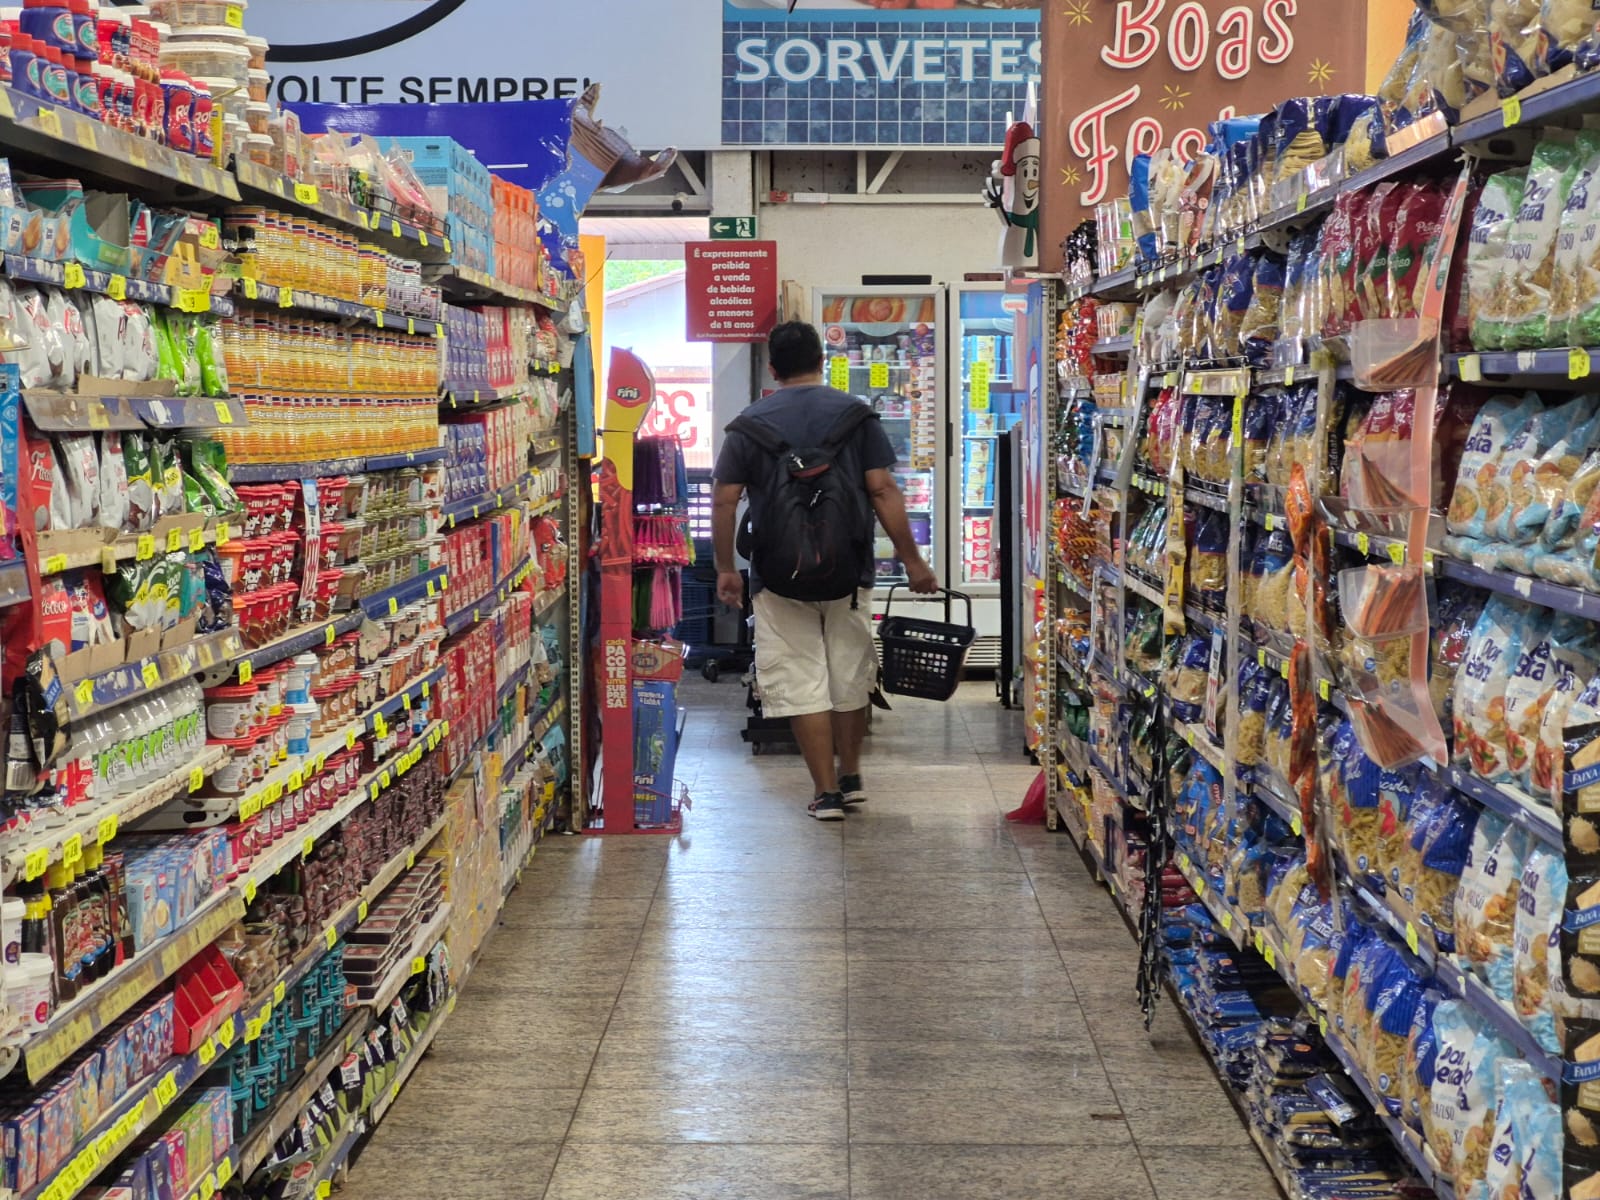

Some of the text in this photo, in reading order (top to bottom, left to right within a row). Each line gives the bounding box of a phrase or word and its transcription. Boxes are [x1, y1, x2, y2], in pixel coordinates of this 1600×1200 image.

[1101, 0, 1297, 80] Boas
[702, 249, 768, 259] expressamente
[712, 261, 750, 271] proibida
[722, 273, 750, 281] venda
[707, 285, 755, 293] de bebidas
[710, 297, 752, 305] alcoólicas
[710, 321, 721, 329] de
[723, 321, 732, 329] 18
[616, 386, 639, 399] Fini
[606, 646, 626, 656] PA
[606, 656, 626, 667] CO
[606, 667, 626, 678] TE
